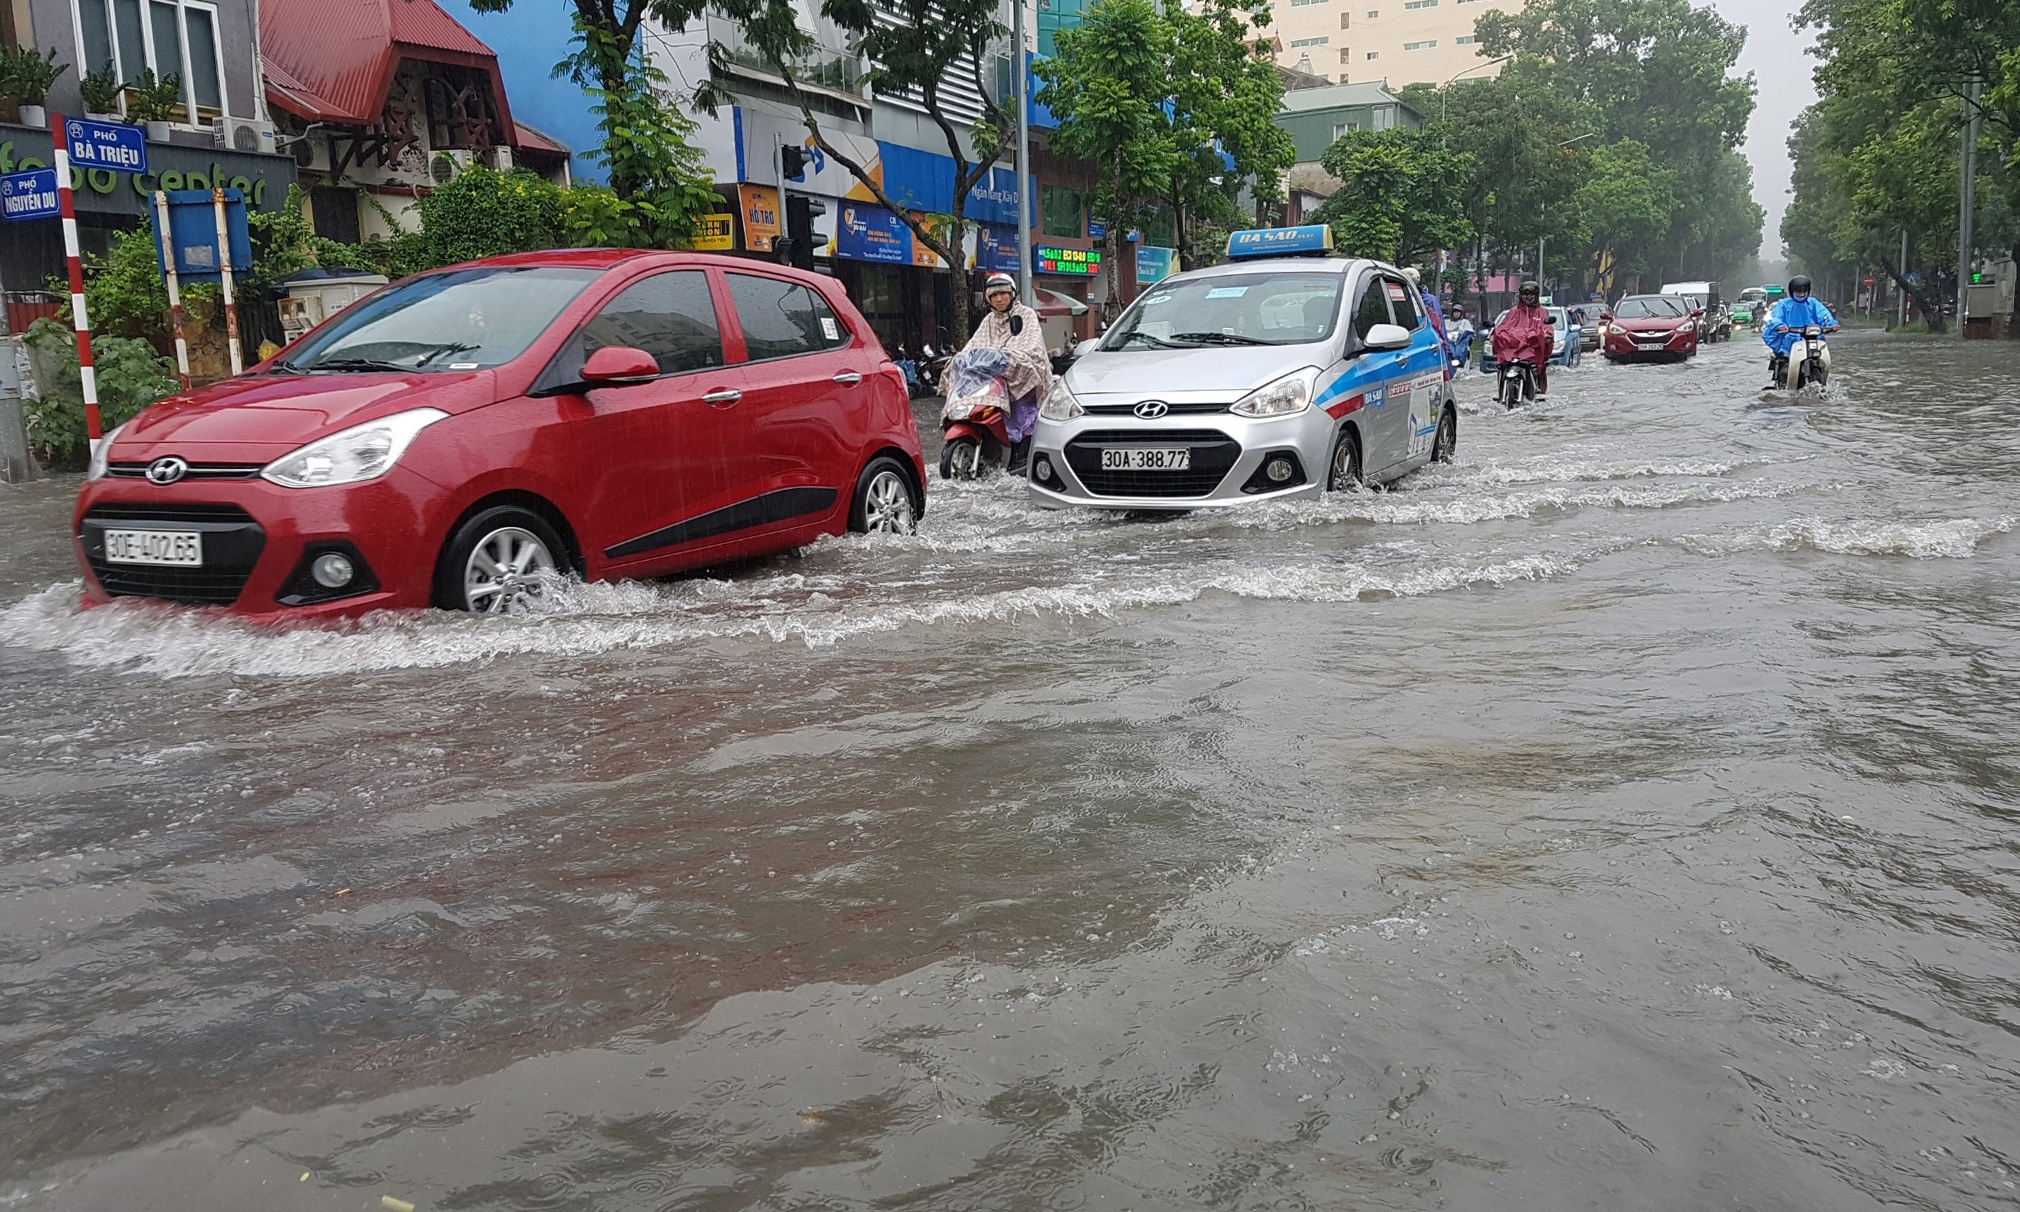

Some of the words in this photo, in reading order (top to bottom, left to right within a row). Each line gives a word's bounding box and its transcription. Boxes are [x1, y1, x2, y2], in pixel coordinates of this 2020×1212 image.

[93, 129, 117, 141] PHỐ
[74, 140, 96, 160] BÀ
[98, 144, 139, 167] TRIỆU
[18, 176, 37, 190] PHỐ
[42, 191, 56, 208] DU
[1239, 233, 1261, 243] BA
[1264, 230, 1299, 242] SAO
[1104, 451, 1187, 468] 30A-388.77
